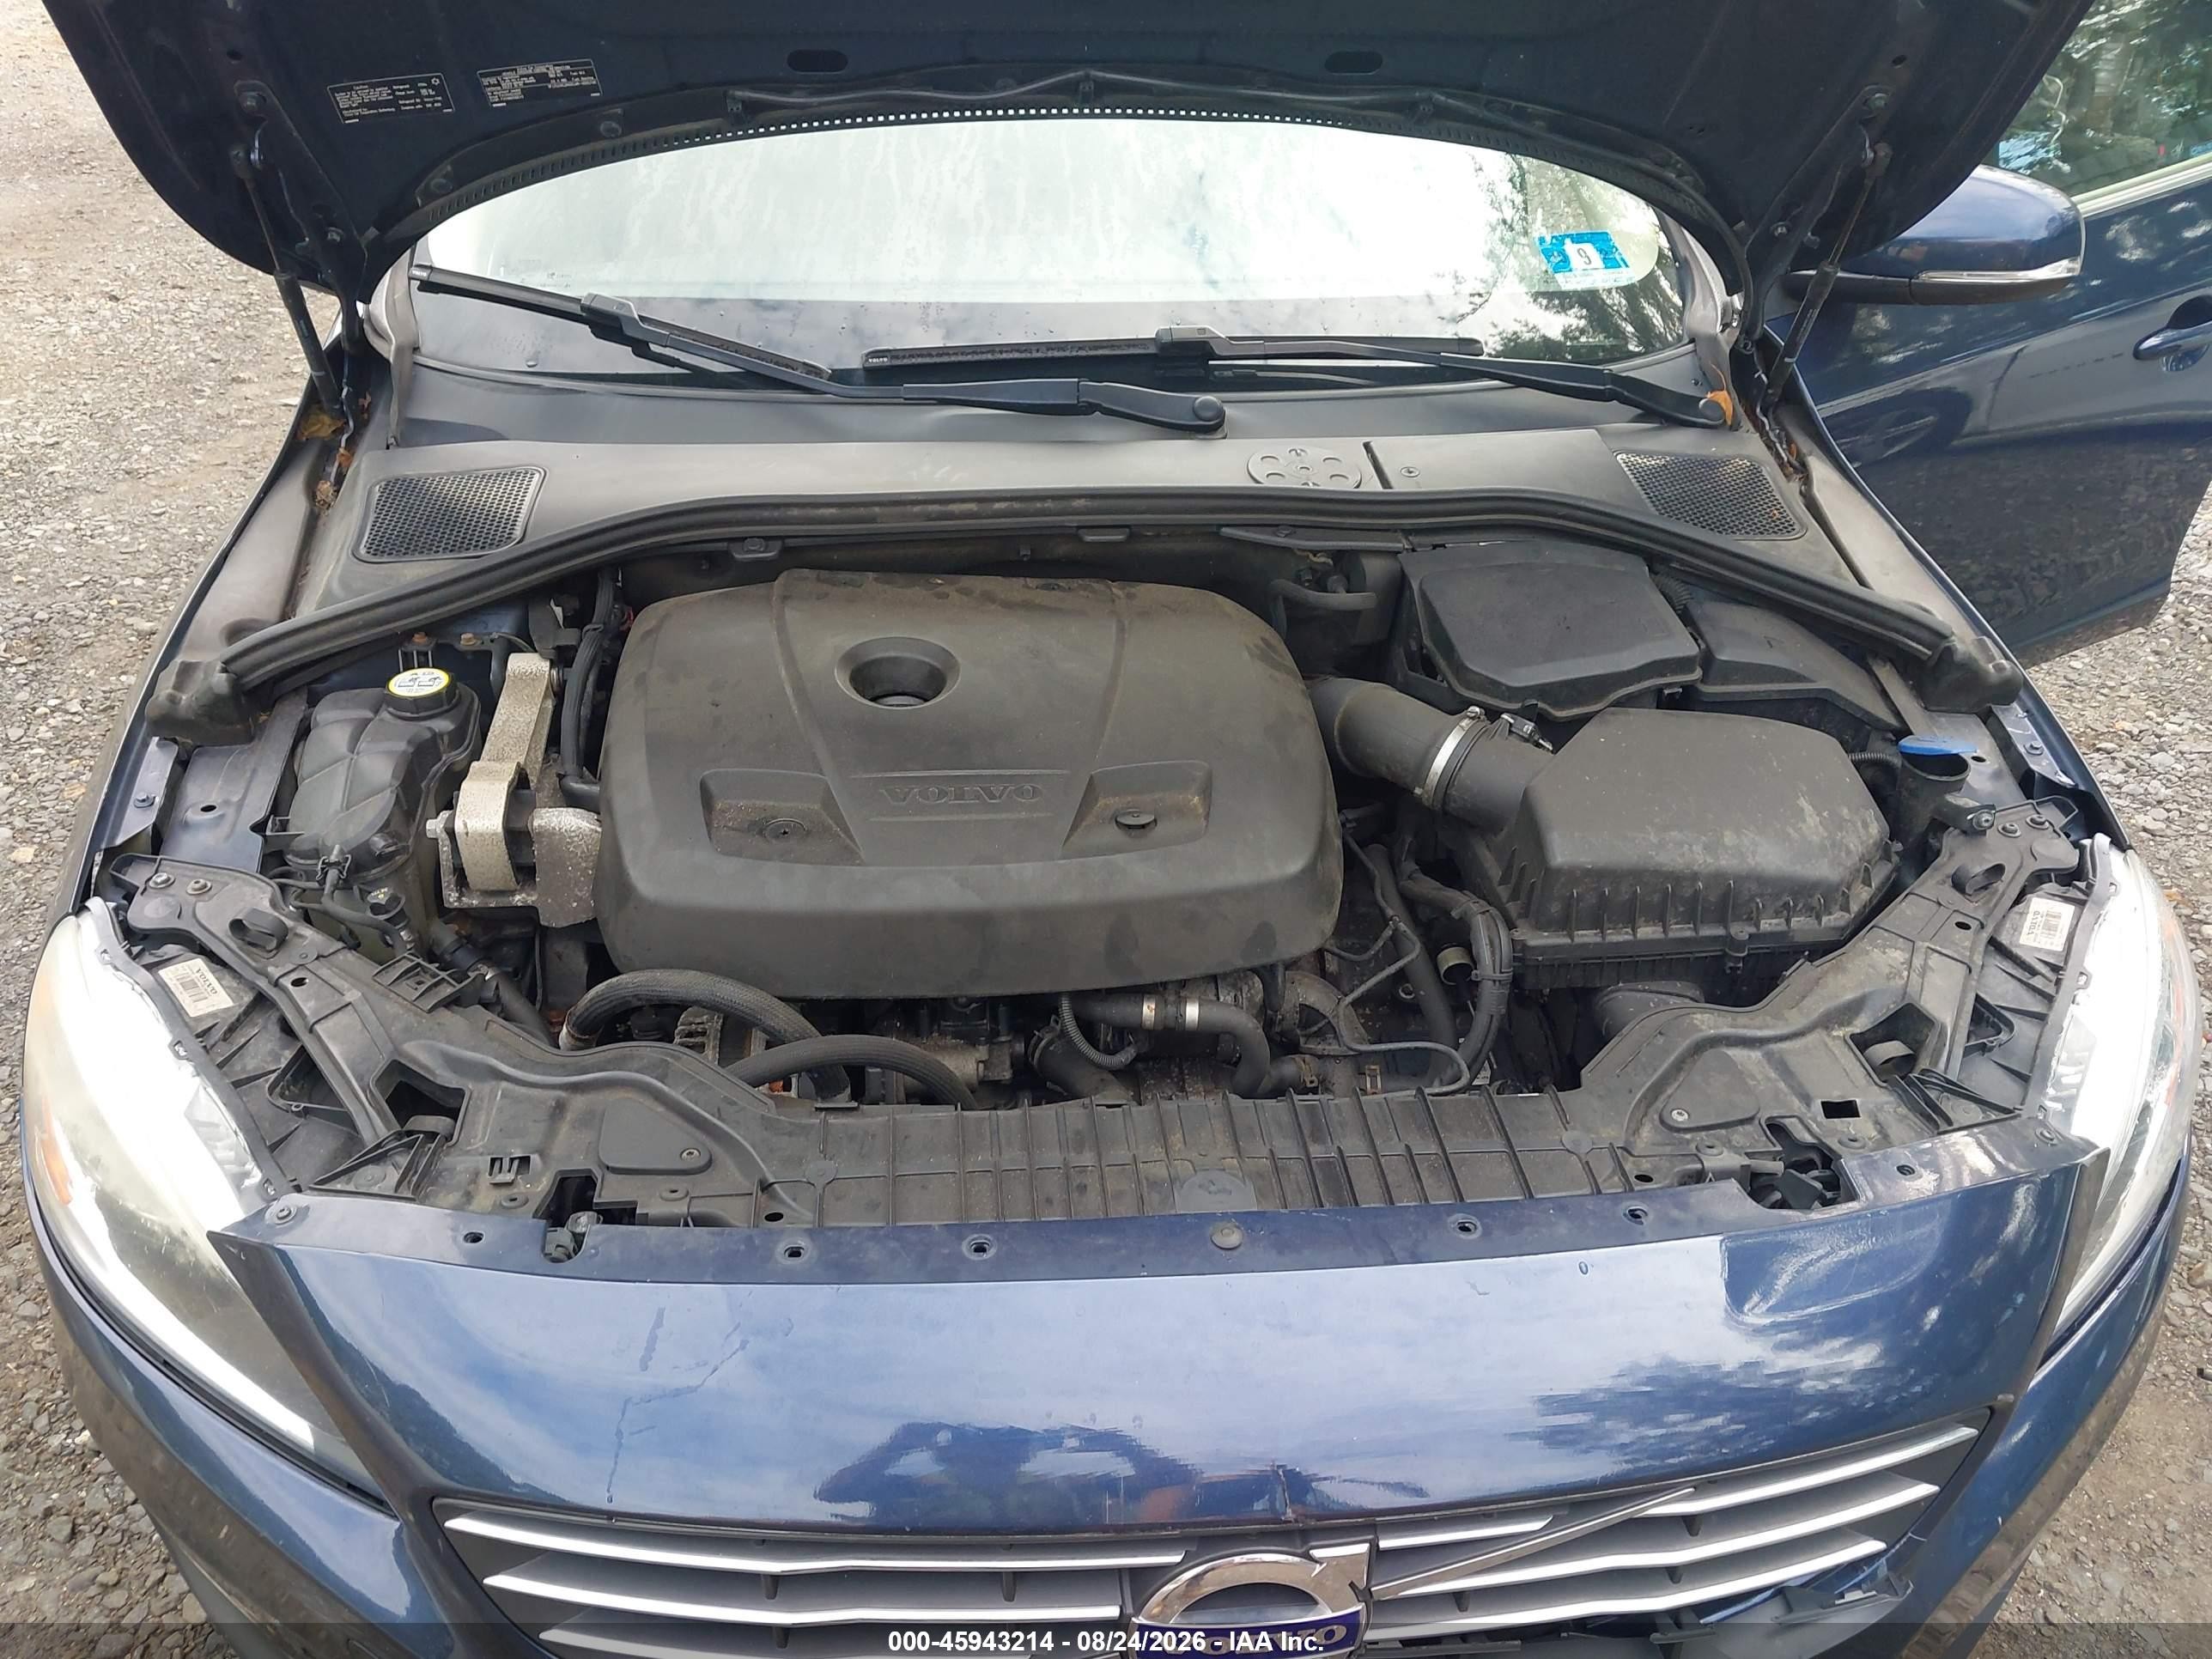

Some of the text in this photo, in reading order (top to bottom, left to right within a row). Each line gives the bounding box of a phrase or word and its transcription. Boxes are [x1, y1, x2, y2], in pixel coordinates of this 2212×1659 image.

[1577, 247, 1592, 265] 9
[879, 783, 1043, 805] VOLVO
[195, 968, 218, 995] VOLVO
